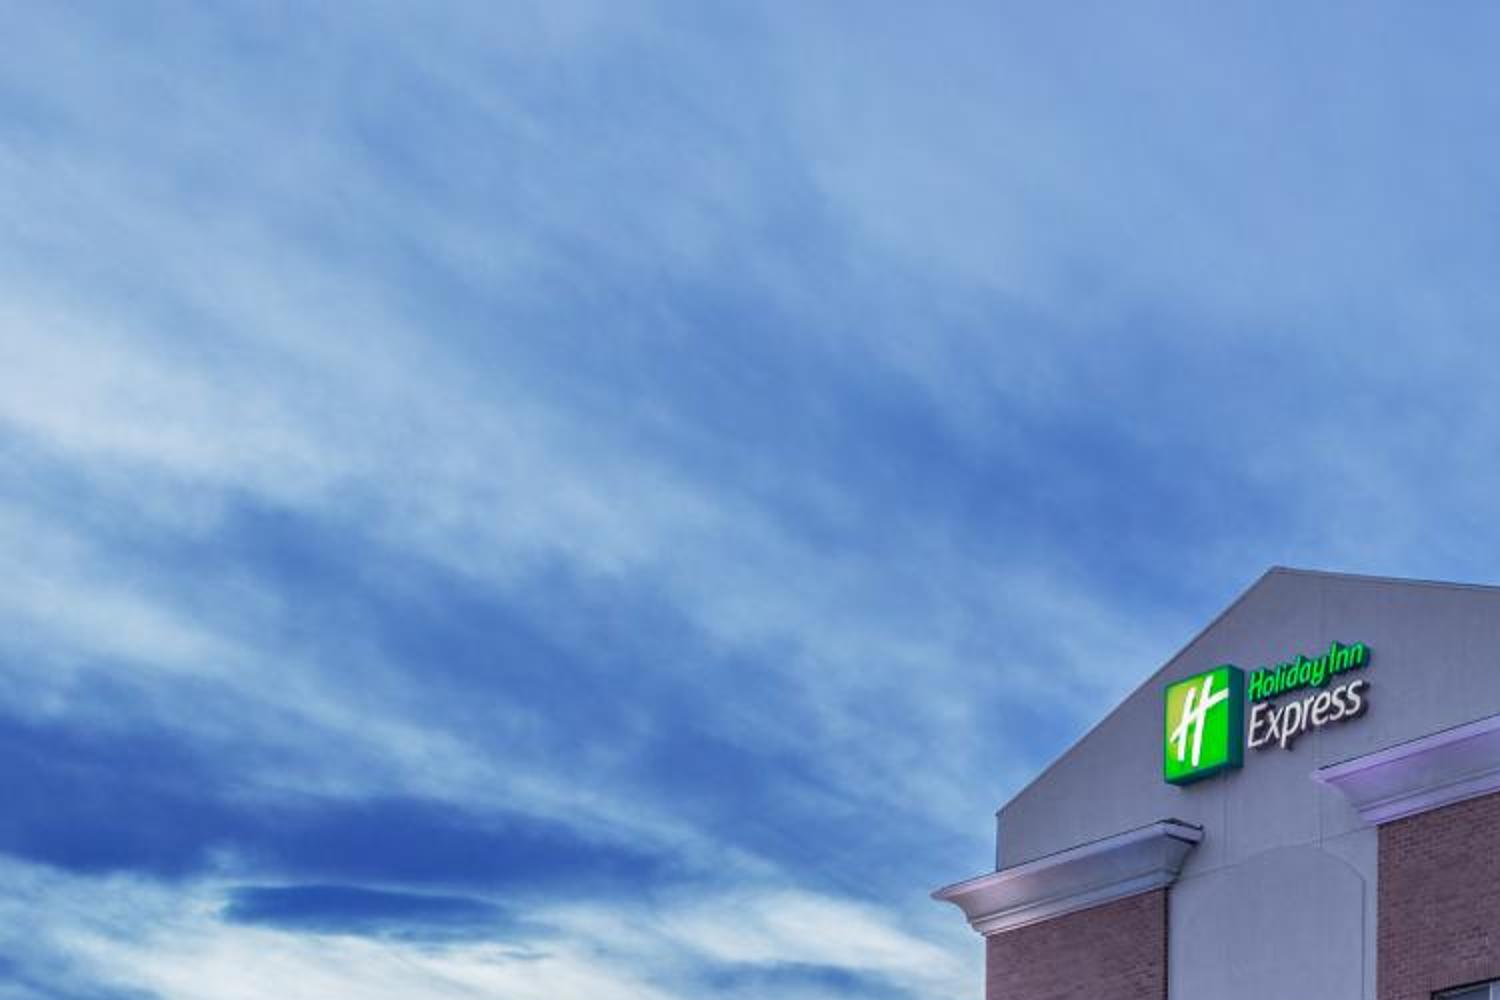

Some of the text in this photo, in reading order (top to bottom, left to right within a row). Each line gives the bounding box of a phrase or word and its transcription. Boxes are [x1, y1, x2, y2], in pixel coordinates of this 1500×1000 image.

[1248, 641, 1367, 699] Holiday Inn
[1248, 679, 1363, 748] Express
